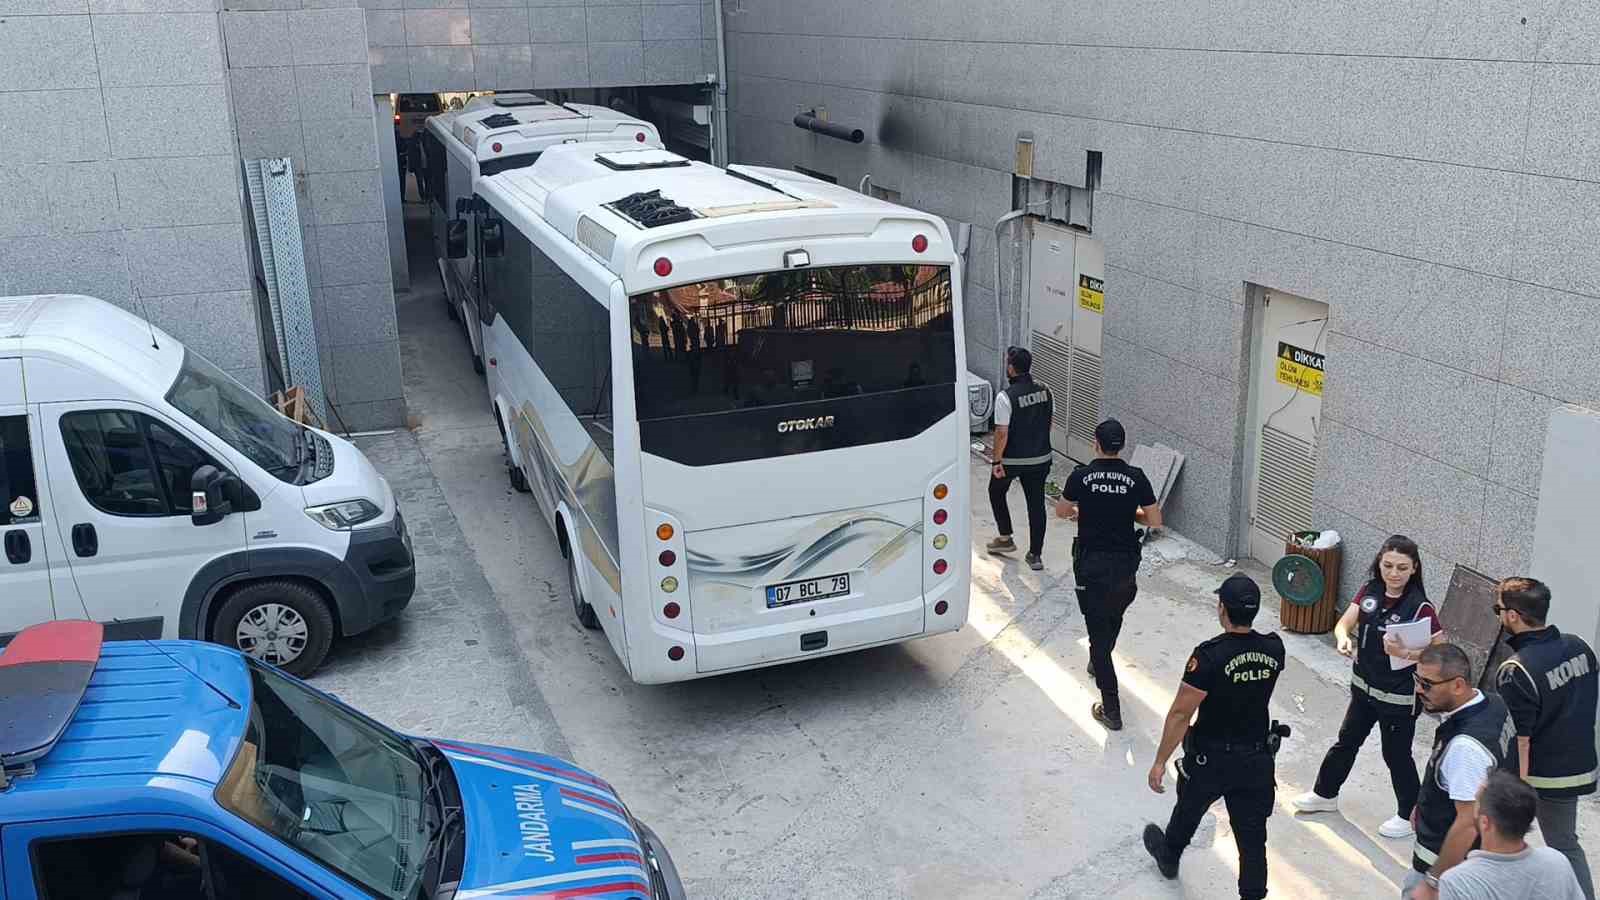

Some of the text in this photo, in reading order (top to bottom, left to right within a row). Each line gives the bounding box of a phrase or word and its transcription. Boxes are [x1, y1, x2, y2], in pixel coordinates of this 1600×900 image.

[1089, 279, 1104, 292] DİKK
[1018, 390, 1048, 408] KOM
[777, 415, 835, 433] OTOKAR
[1106, 471, 1136, 488] KUVVET
[776, 576, 846, 601] 07 BCL 79
[1246, 651, 1279, 671] KUVVET
[1545, 653, 1590, 691] KOM
[511, 783, 556, 863] JANDARMA
